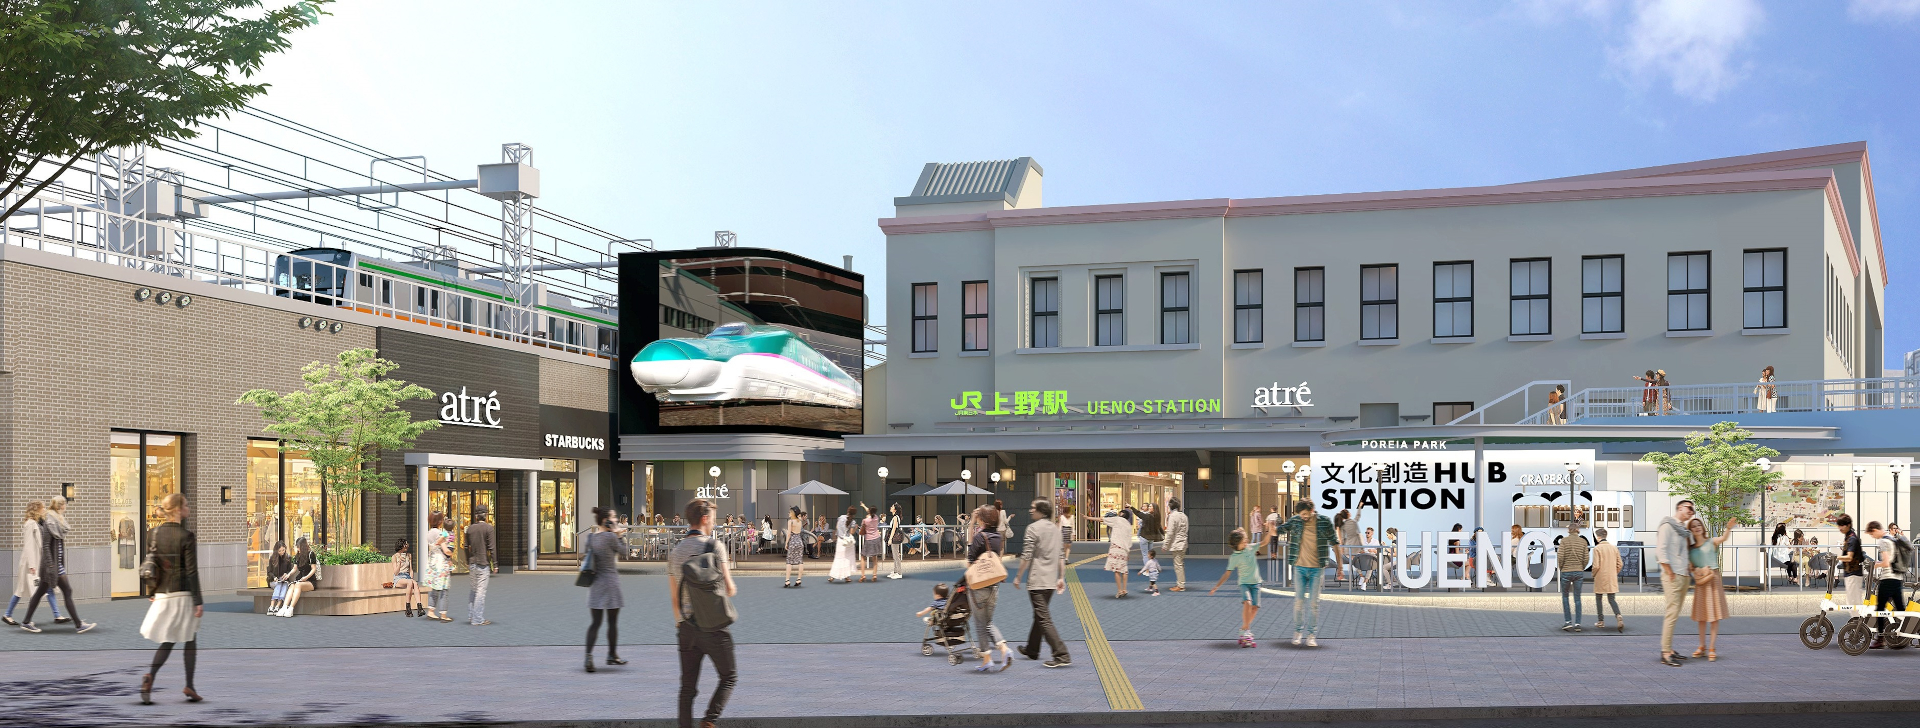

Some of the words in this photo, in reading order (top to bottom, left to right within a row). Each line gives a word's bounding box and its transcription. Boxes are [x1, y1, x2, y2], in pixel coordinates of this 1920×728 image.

[950, 390, 983, 410] JR
[985, 390, 1069, 415] 上野駅
[1252, 381, 1313, 407] atré
[440, 386, 502, 427] atré
[1087, 400, 1136, 415] UENO
[1143, 398, 1221, 414] STATION
[545, 433, 605, 451] STARBUCKS
[1361, 440, 1409, 449] POREIA
[1413, 440, 1447, 450] PARK
[1434, 461, 1507, 484] HUB
[696, 483, 729, 499] atré
[1321, 488, 1466, 510] STATION
[1397, 530, 1557, 589] UENO
